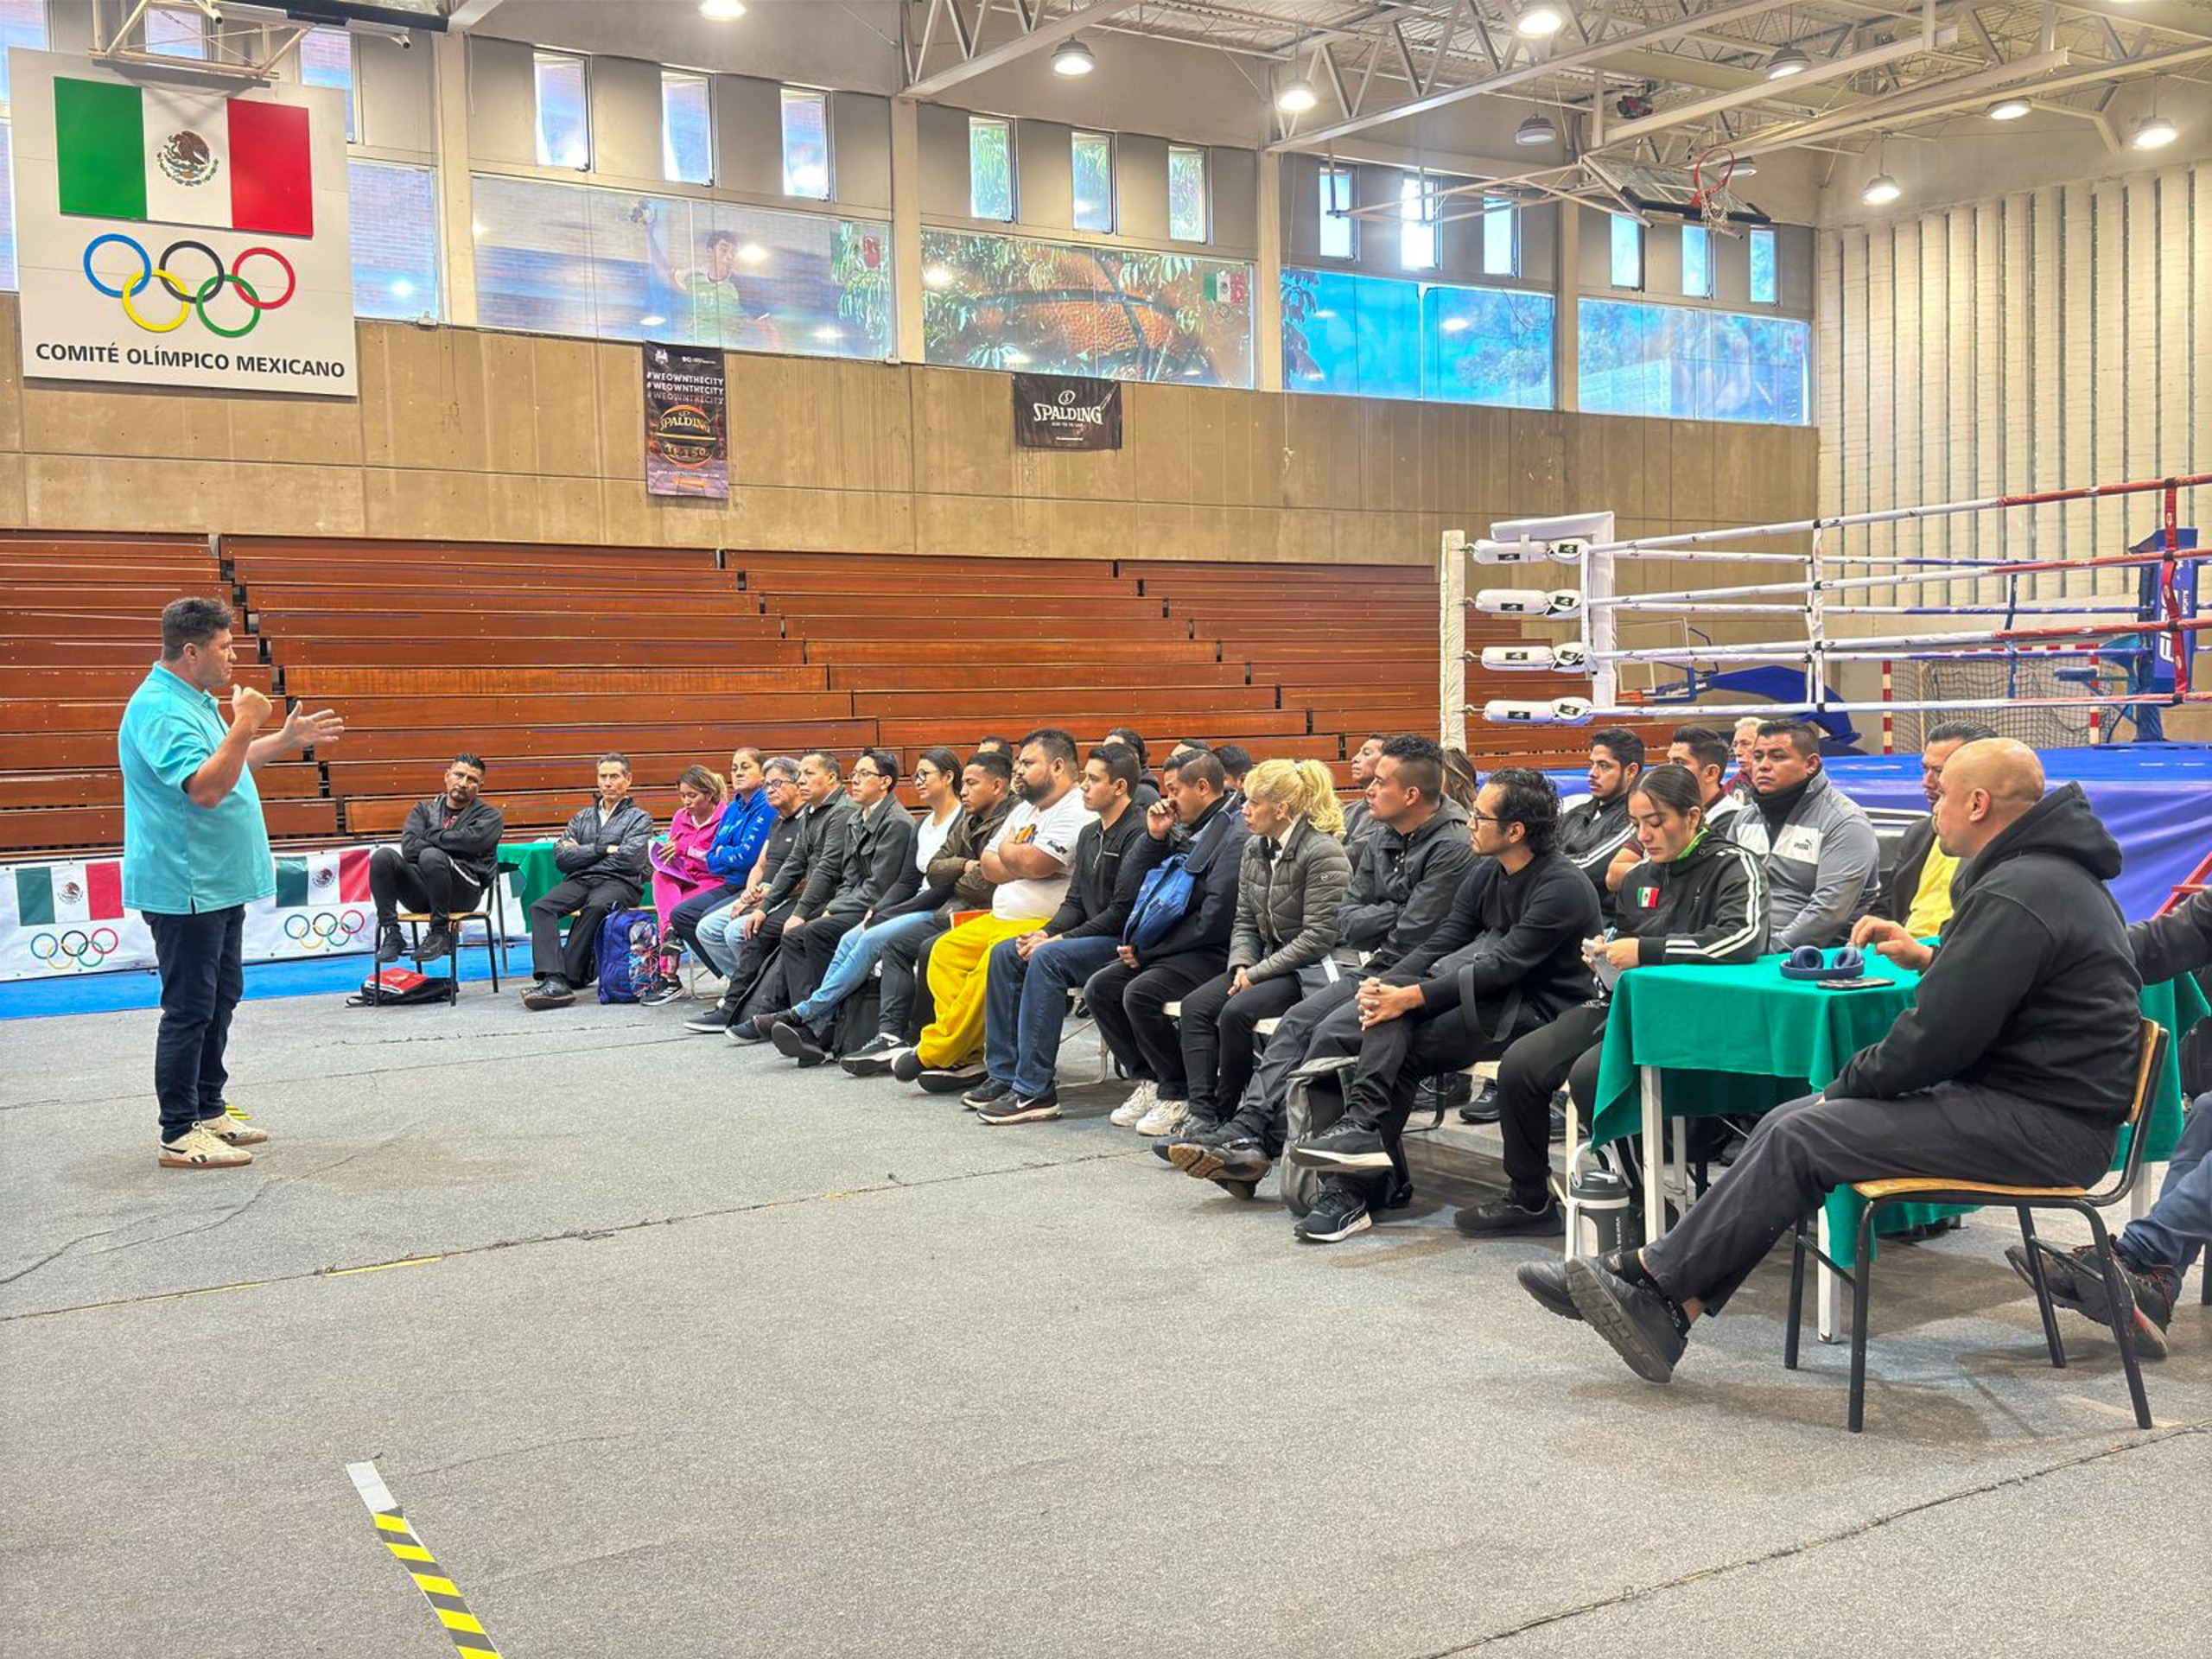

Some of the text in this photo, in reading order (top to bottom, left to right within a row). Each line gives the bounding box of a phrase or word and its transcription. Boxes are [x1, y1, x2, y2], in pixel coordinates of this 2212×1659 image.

[35, 342, 346, 378] COMITÉ OLÍMPICO MEXICANO
[646, 371, 724, 386] #WEOWNTHECITY
[646, 381, 724, 395] #WEOWNTHECITY
[1033, 403, 1104, 424] SPALDING
[659, 416, 710, 433] SPALDING
